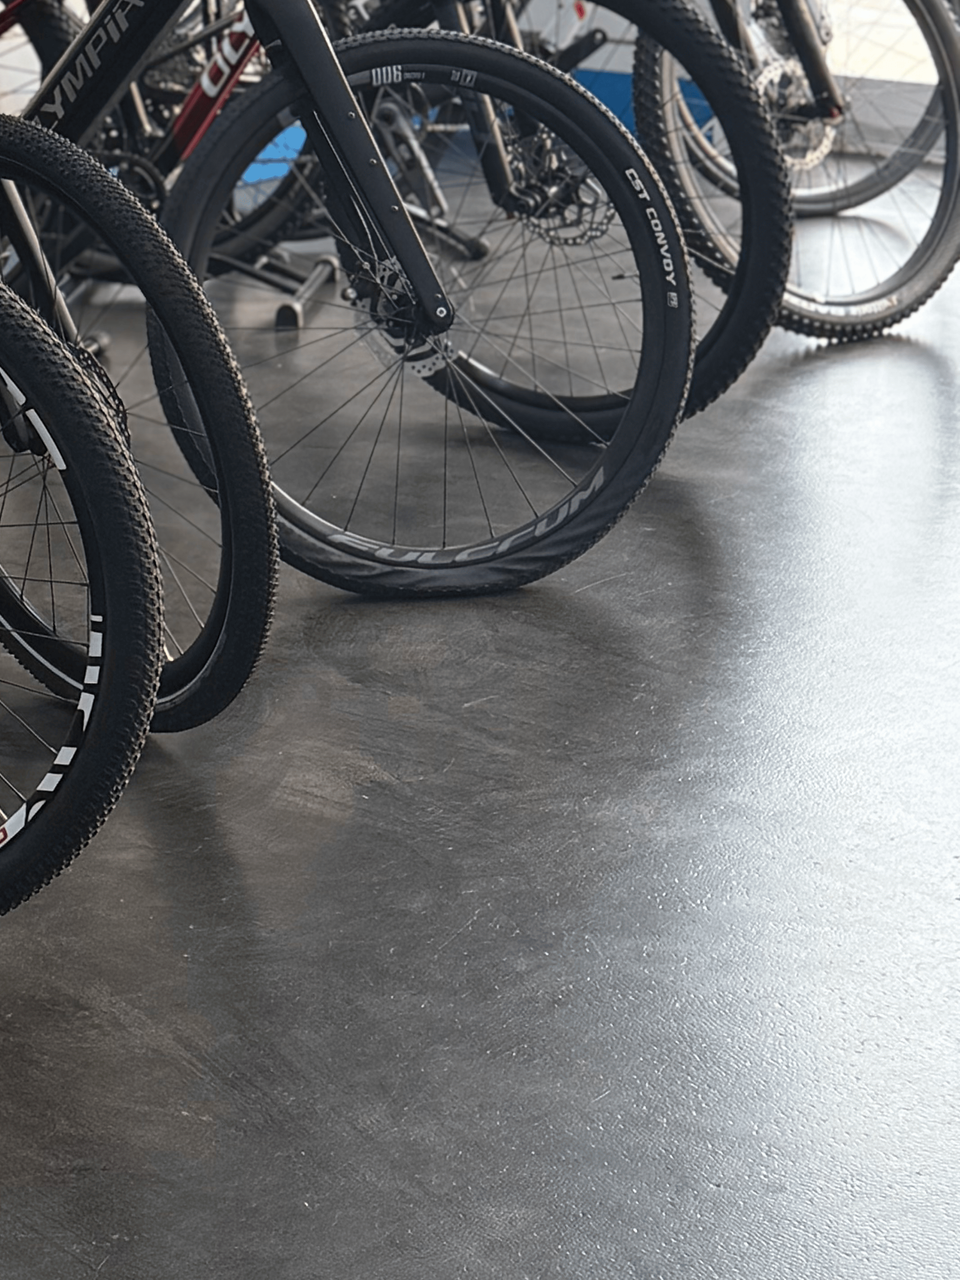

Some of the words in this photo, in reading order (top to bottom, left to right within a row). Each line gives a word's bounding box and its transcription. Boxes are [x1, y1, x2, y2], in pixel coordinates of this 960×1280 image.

[625, 168, 651, 202] CST
[646, 207, 677, 287] CONVOY
[327, 466, 605, 565] FULCRUM
